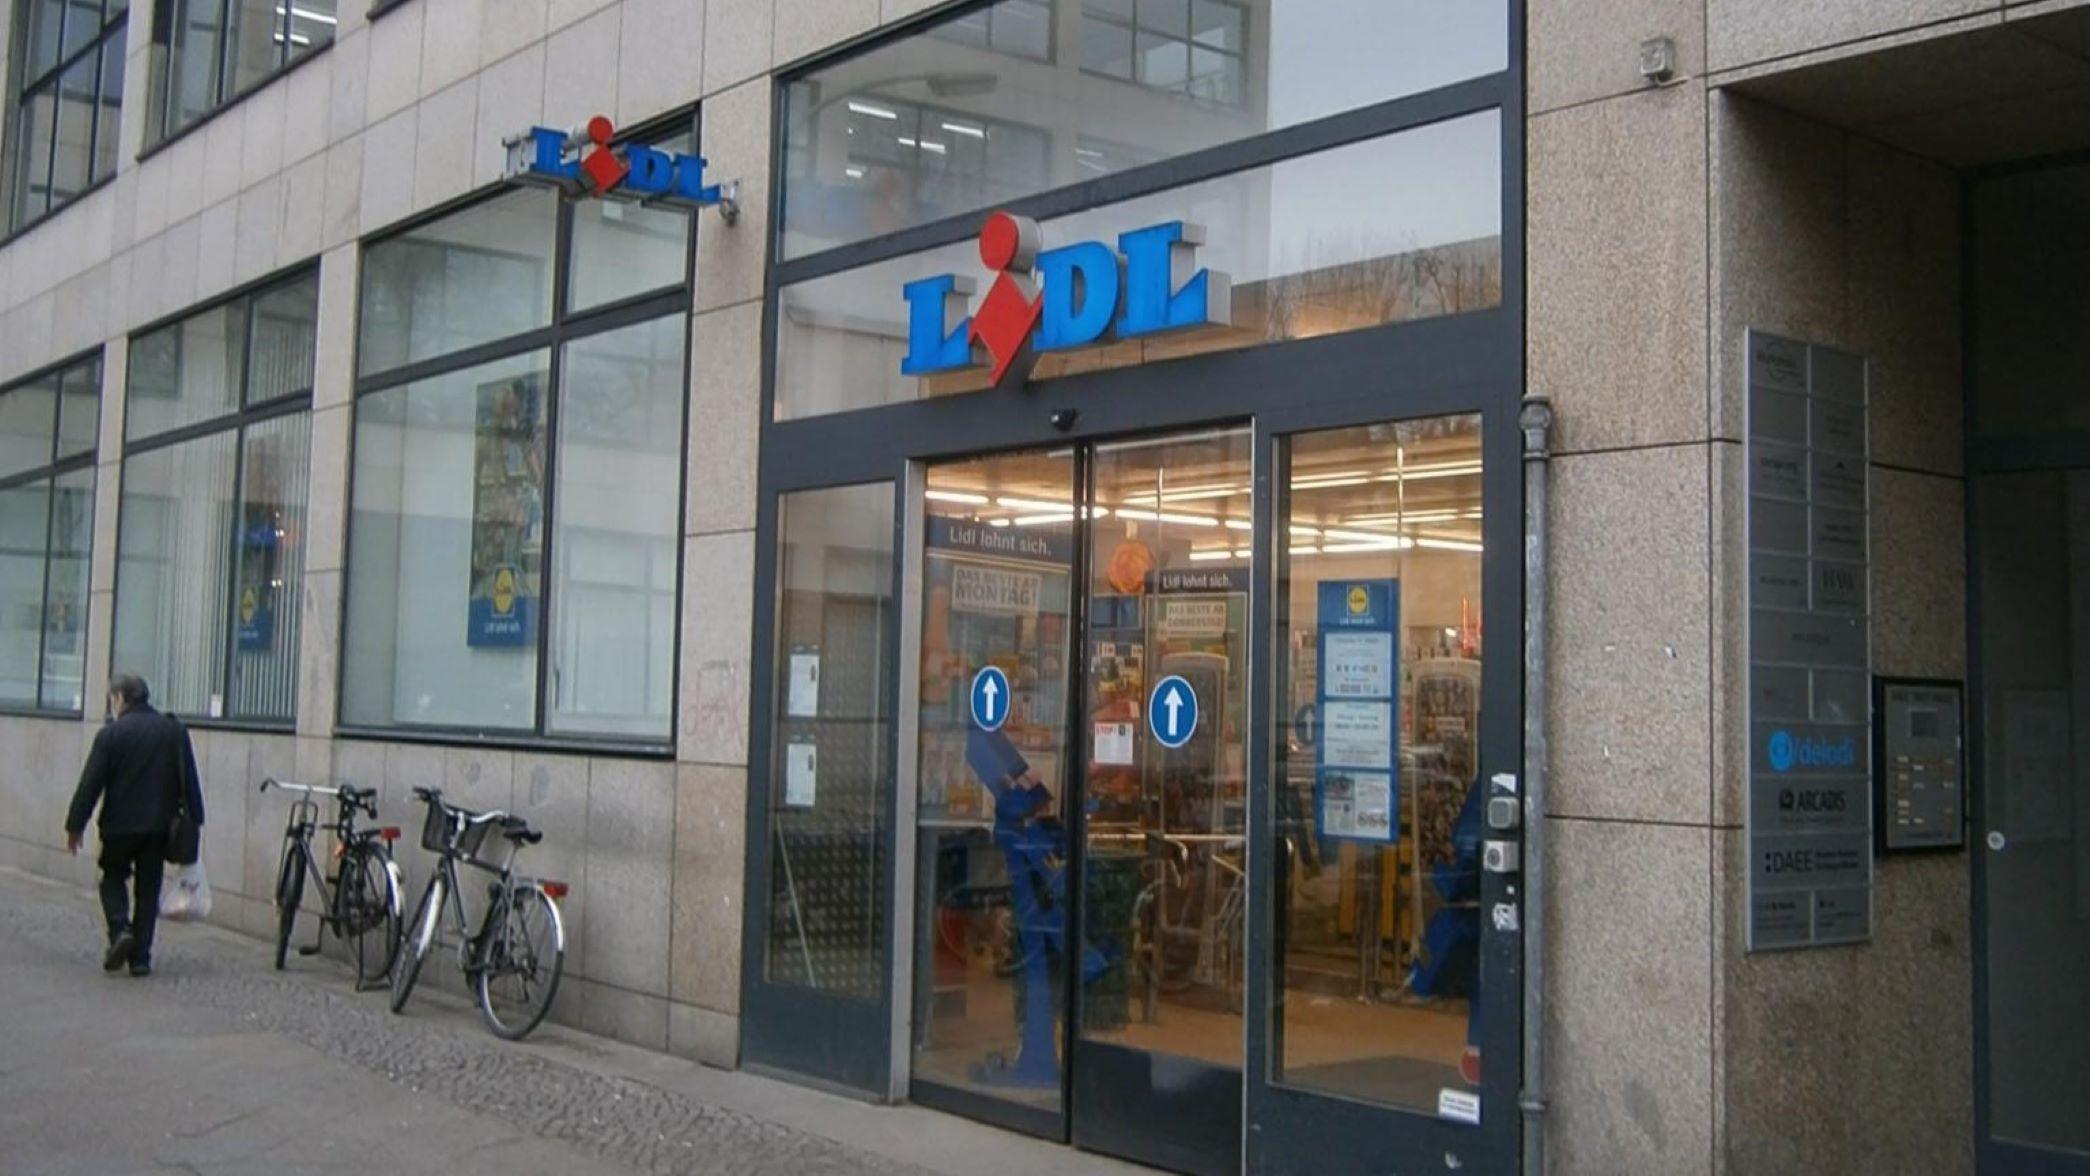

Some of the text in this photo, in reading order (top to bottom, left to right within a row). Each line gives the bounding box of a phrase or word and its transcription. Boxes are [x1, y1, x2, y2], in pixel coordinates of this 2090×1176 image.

[949, 526, 1052, 556] Lidl lohnt sich.
